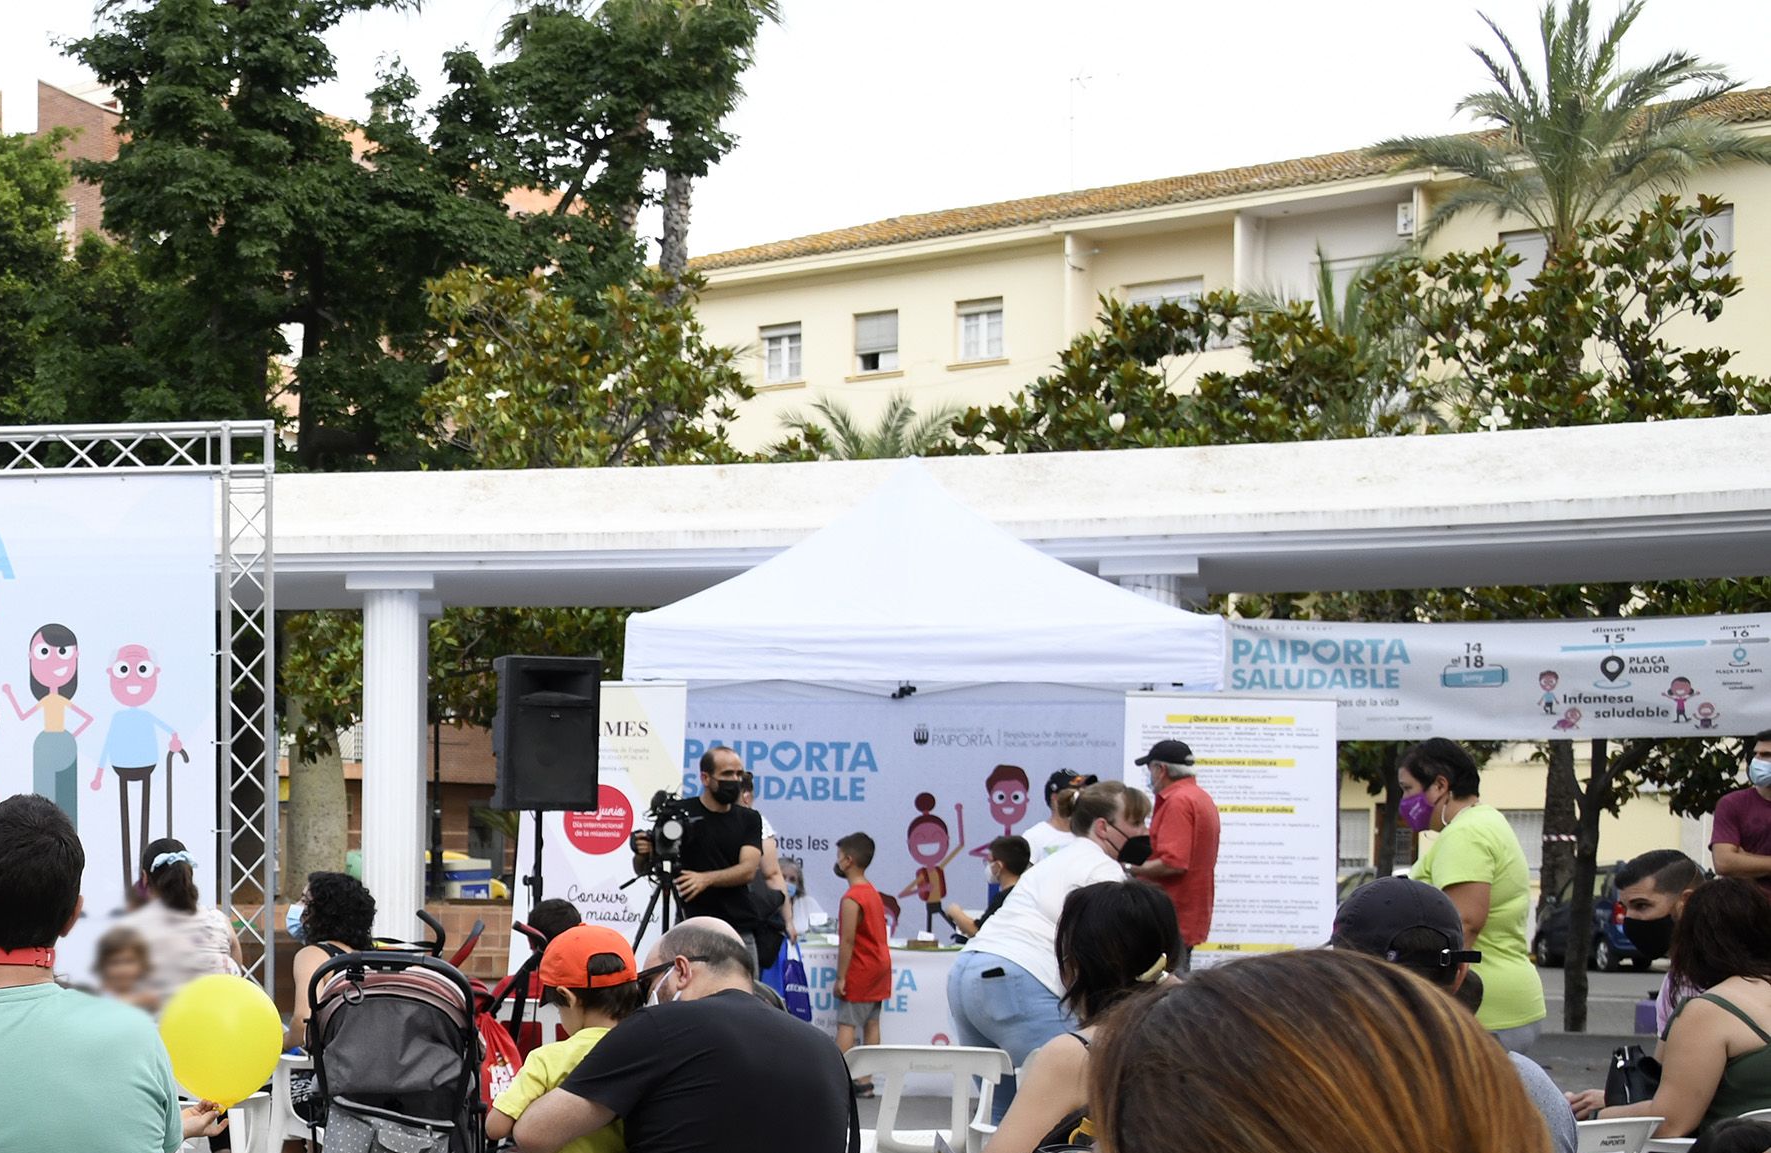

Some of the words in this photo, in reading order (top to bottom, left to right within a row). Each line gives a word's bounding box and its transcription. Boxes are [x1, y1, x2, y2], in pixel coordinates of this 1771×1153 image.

[1592, 626, 1636, 634] dimarts
[1732, 630, 1749, 638] 16
[1603, 633, 1625, 644] 15
[1231, 638, 1411, 665] PAIPORTA
[1465, 642, 1483, 654] 14
[1464, 655, 1484, 669] 18
[1629, 655, 1666, 665] PLAÇA
[1629, 665, 1670, 674] MAJOR
[1231, 667, 1400, 690] SALUDABLE
[1380, 697, 1400, 707] vida
[1563, 693, 1634, 704] Infantesa
[1594, 706, 1669, 719] saludable
[600, 721, 649, 737] MES
[687, 722, 726, 730] ETMANA
[730, 723, 741, 731] DE
[747, 723, 759, 731] LA
[764, 723, 793, 731] SALUT
[931, 733, 994, 747] PAIPORTA
[572, 821, 583, 829] Día
[583, 821, 624, 829] internacional
[775, 836, 803, 851] otes
[807, 835, 829, 851] les
[567, 884, 628, 904] Convive
[586, 906, 660, 923] miastena
